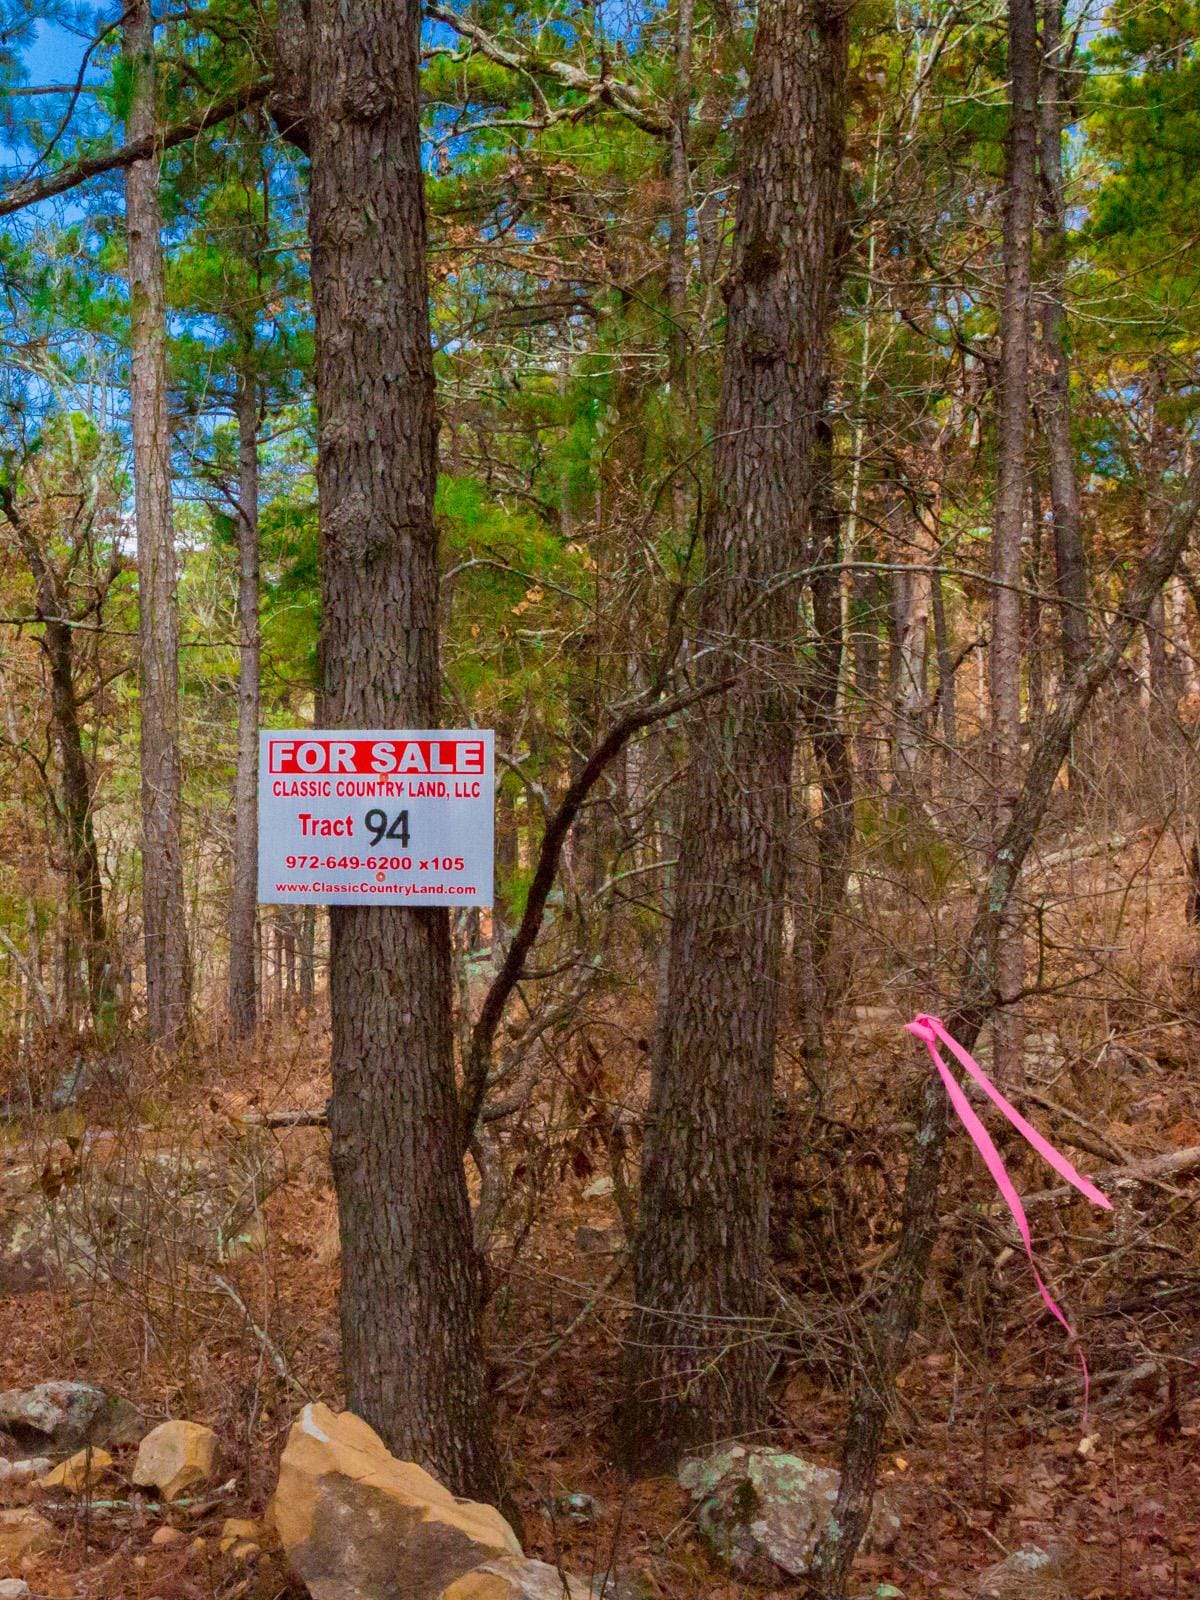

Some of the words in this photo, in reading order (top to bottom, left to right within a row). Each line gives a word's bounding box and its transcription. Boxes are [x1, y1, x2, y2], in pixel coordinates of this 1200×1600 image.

[272, 742, 356, 772] FOR
[371, 742, 480, 772] SALE
[273, 781, 330, 797] CLASSIC
[336, 781, 402, 797] COUNTRY
[408, 782, 450, 800] LAND,
[455, 782, 480, 798] LLC
[299, 814, 353, 837] Tract
[364, 809, 410, 848] 94
[286, 856, 411, 869] 972-649-6200
[419, 858, 464, 870] x105
[276, 882, 476, 896] www.ClassicCountryLand.com
